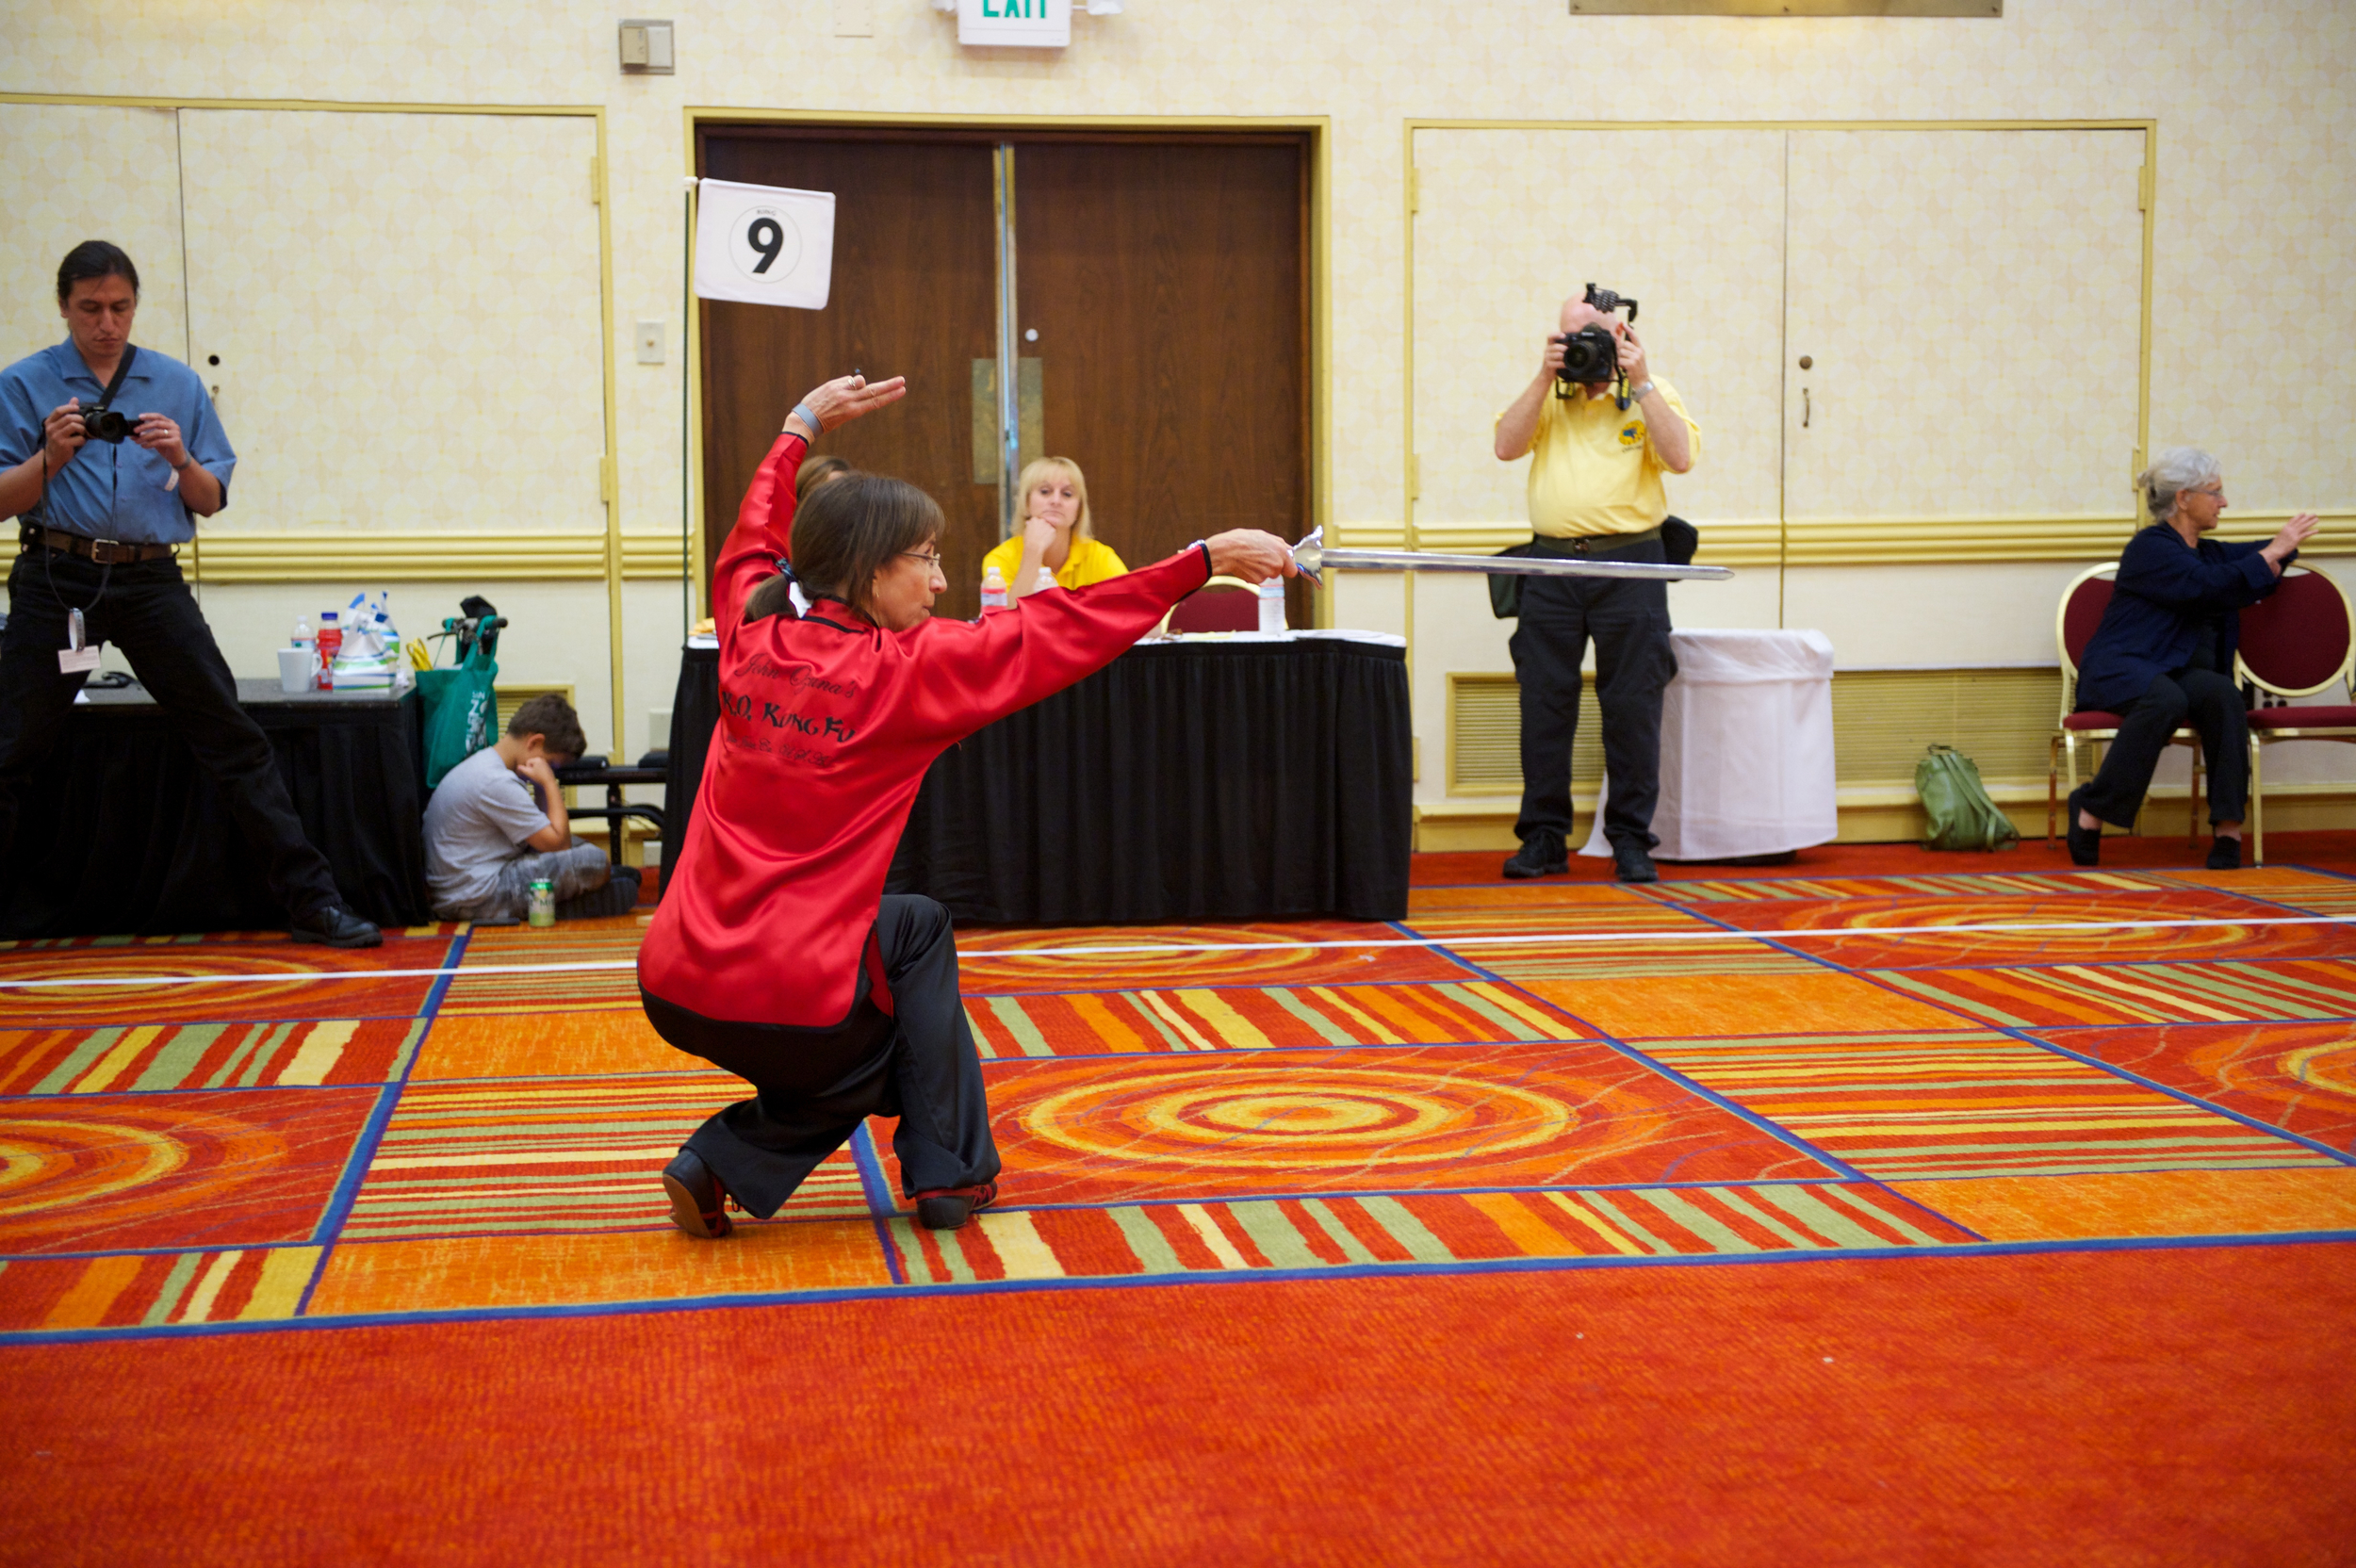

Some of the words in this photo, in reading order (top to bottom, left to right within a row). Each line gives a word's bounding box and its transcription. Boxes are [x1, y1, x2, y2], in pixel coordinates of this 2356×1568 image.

[747, 217, 783, 274] 9
[734, 652, 780, 679] John
[822, 716, 857, 743] FU
